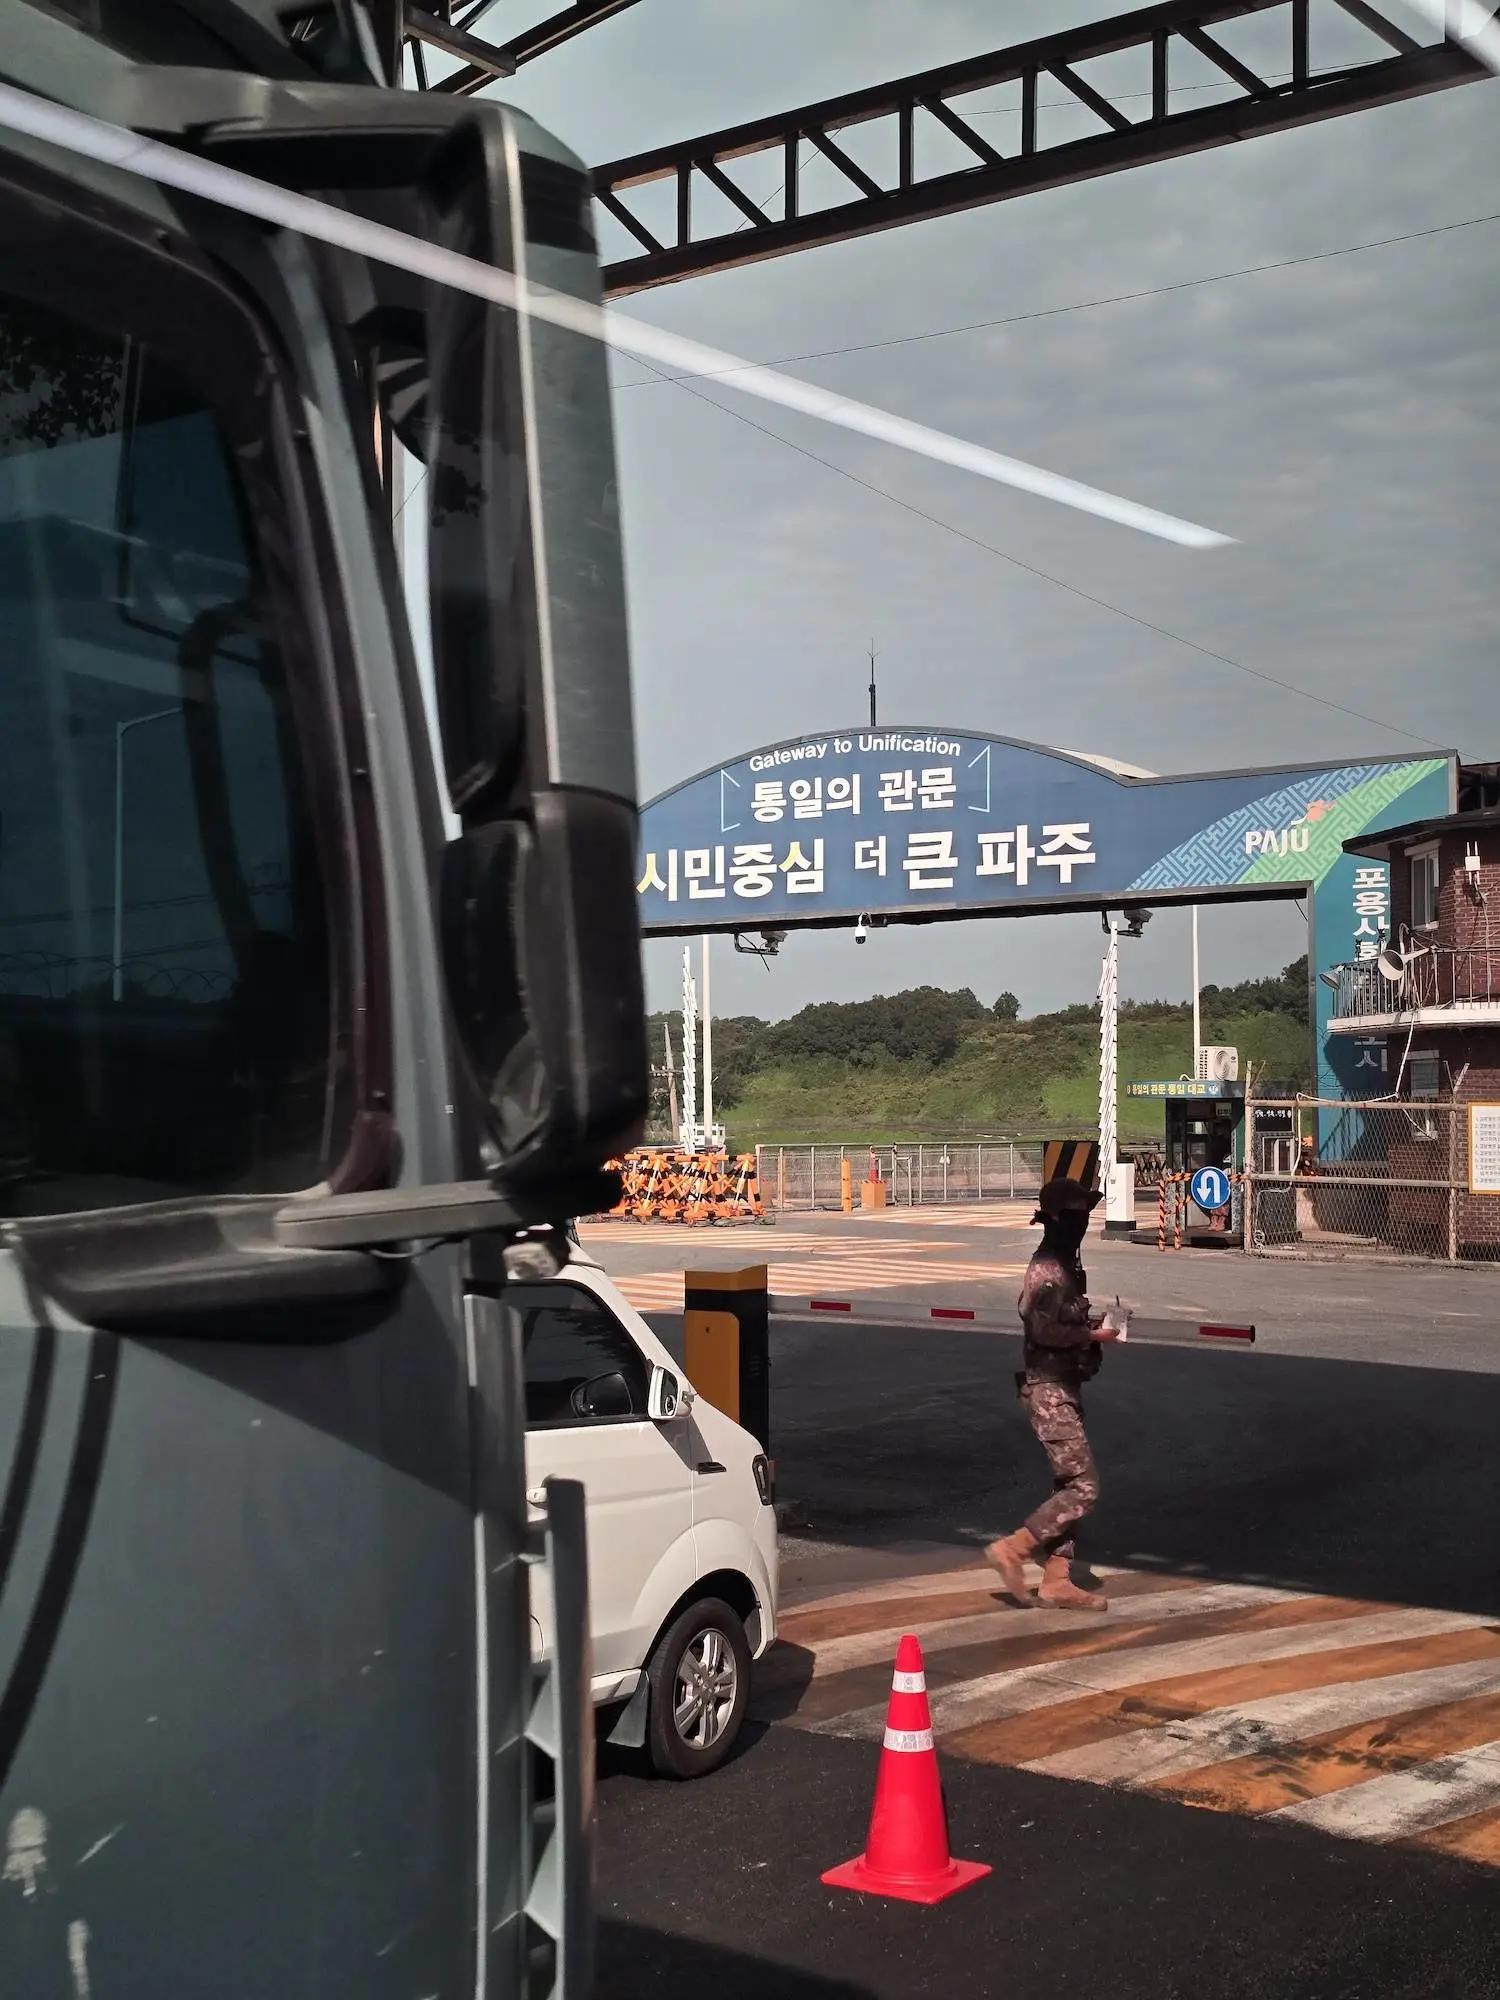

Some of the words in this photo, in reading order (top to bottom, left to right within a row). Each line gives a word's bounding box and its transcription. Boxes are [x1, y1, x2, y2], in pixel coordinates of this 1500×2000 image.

[749, 743, 827, 772] Gateway
[834, 738, 852, 754] to
[859, 734, 961, 757] Unification
[751, 773, 860, 822] 통일의
[878, 767, 957, 812] 관문
[636, 838, 824, 901] 시민중심
[854, 835, 887, 877] 더
[902, 830, 959, 890] 큰
[975, 822, 1096, 886] 파주
[1245, 828, 1309, 857] PAJU
